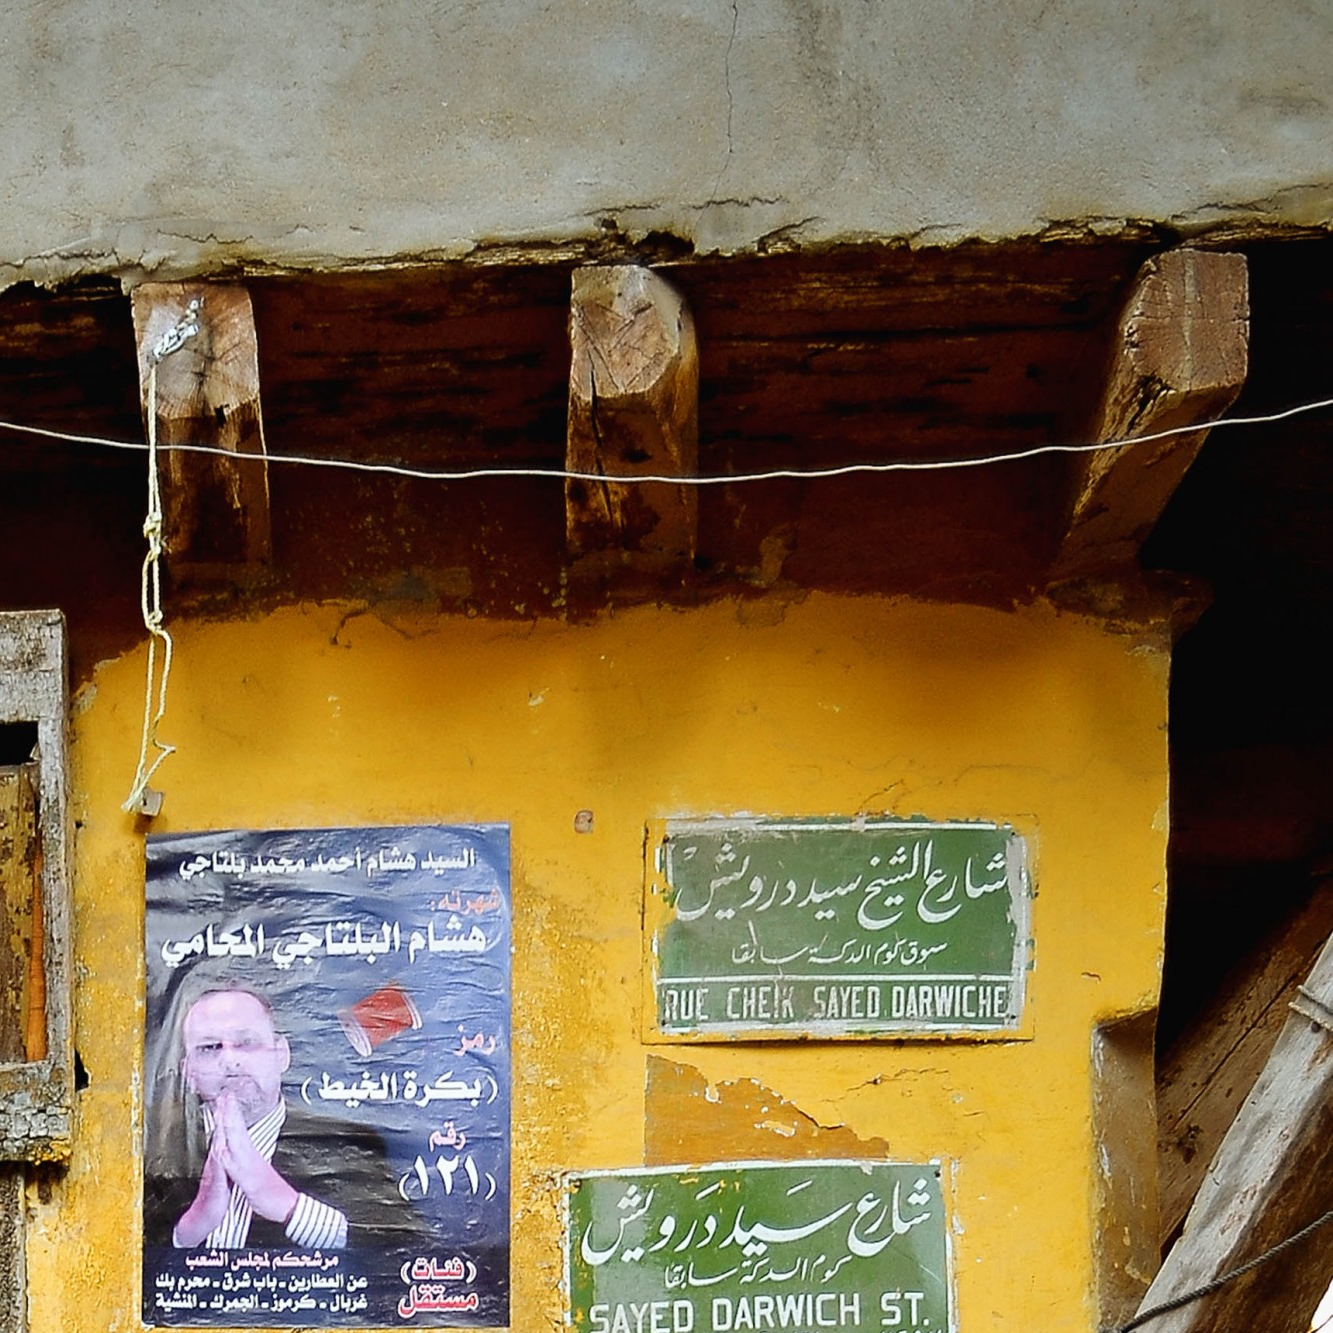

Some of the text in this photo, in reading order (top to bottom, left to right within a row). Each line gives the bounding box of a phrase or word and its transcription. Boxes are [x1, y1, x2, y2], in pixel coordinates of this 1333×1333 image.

[251, 852, 305, 873] محمد
[312, 847, 361, 872] أحمد
[368, 847, 417, 877] هشام
[422, 848, 476, 875] السيد
[675, 839, 1009, 930] شارع الشيخ سيد درويش
[160, 914, 489, 969] هشام البلتاجي المحامي
[900, 940, 948, 966] سوق
[664, 987, 710, 1021] RUE
[813, 985, 882, 1018] SAYED
[891, 984, 1009, 1019] DARWICHE
[452, 1024, 497, 1056] رمز
[428, 1121, 467, 1152] رقم
[846, 1177, 933, 1258] شارع
[185, 1249, 339, 1271] مرشحكم لمجلس الشعب
[810, 1254, 852, 1283] كوم
[155, 1272, 176, 1291] بك
[222, 1272, 252, 1291] شرق
[253, 1276, 278, 1292] باب
[346, 1274, 369, 1292] عن
[210, 1293, 259, 1312] الجمرك
[271, 1292, 317, 1312] كرموز
[397, 1284, 480, 1318] مستقل
[712, 1292, 861, 1332] DARWICH
[880, 1291, 931, 1326] ST.
